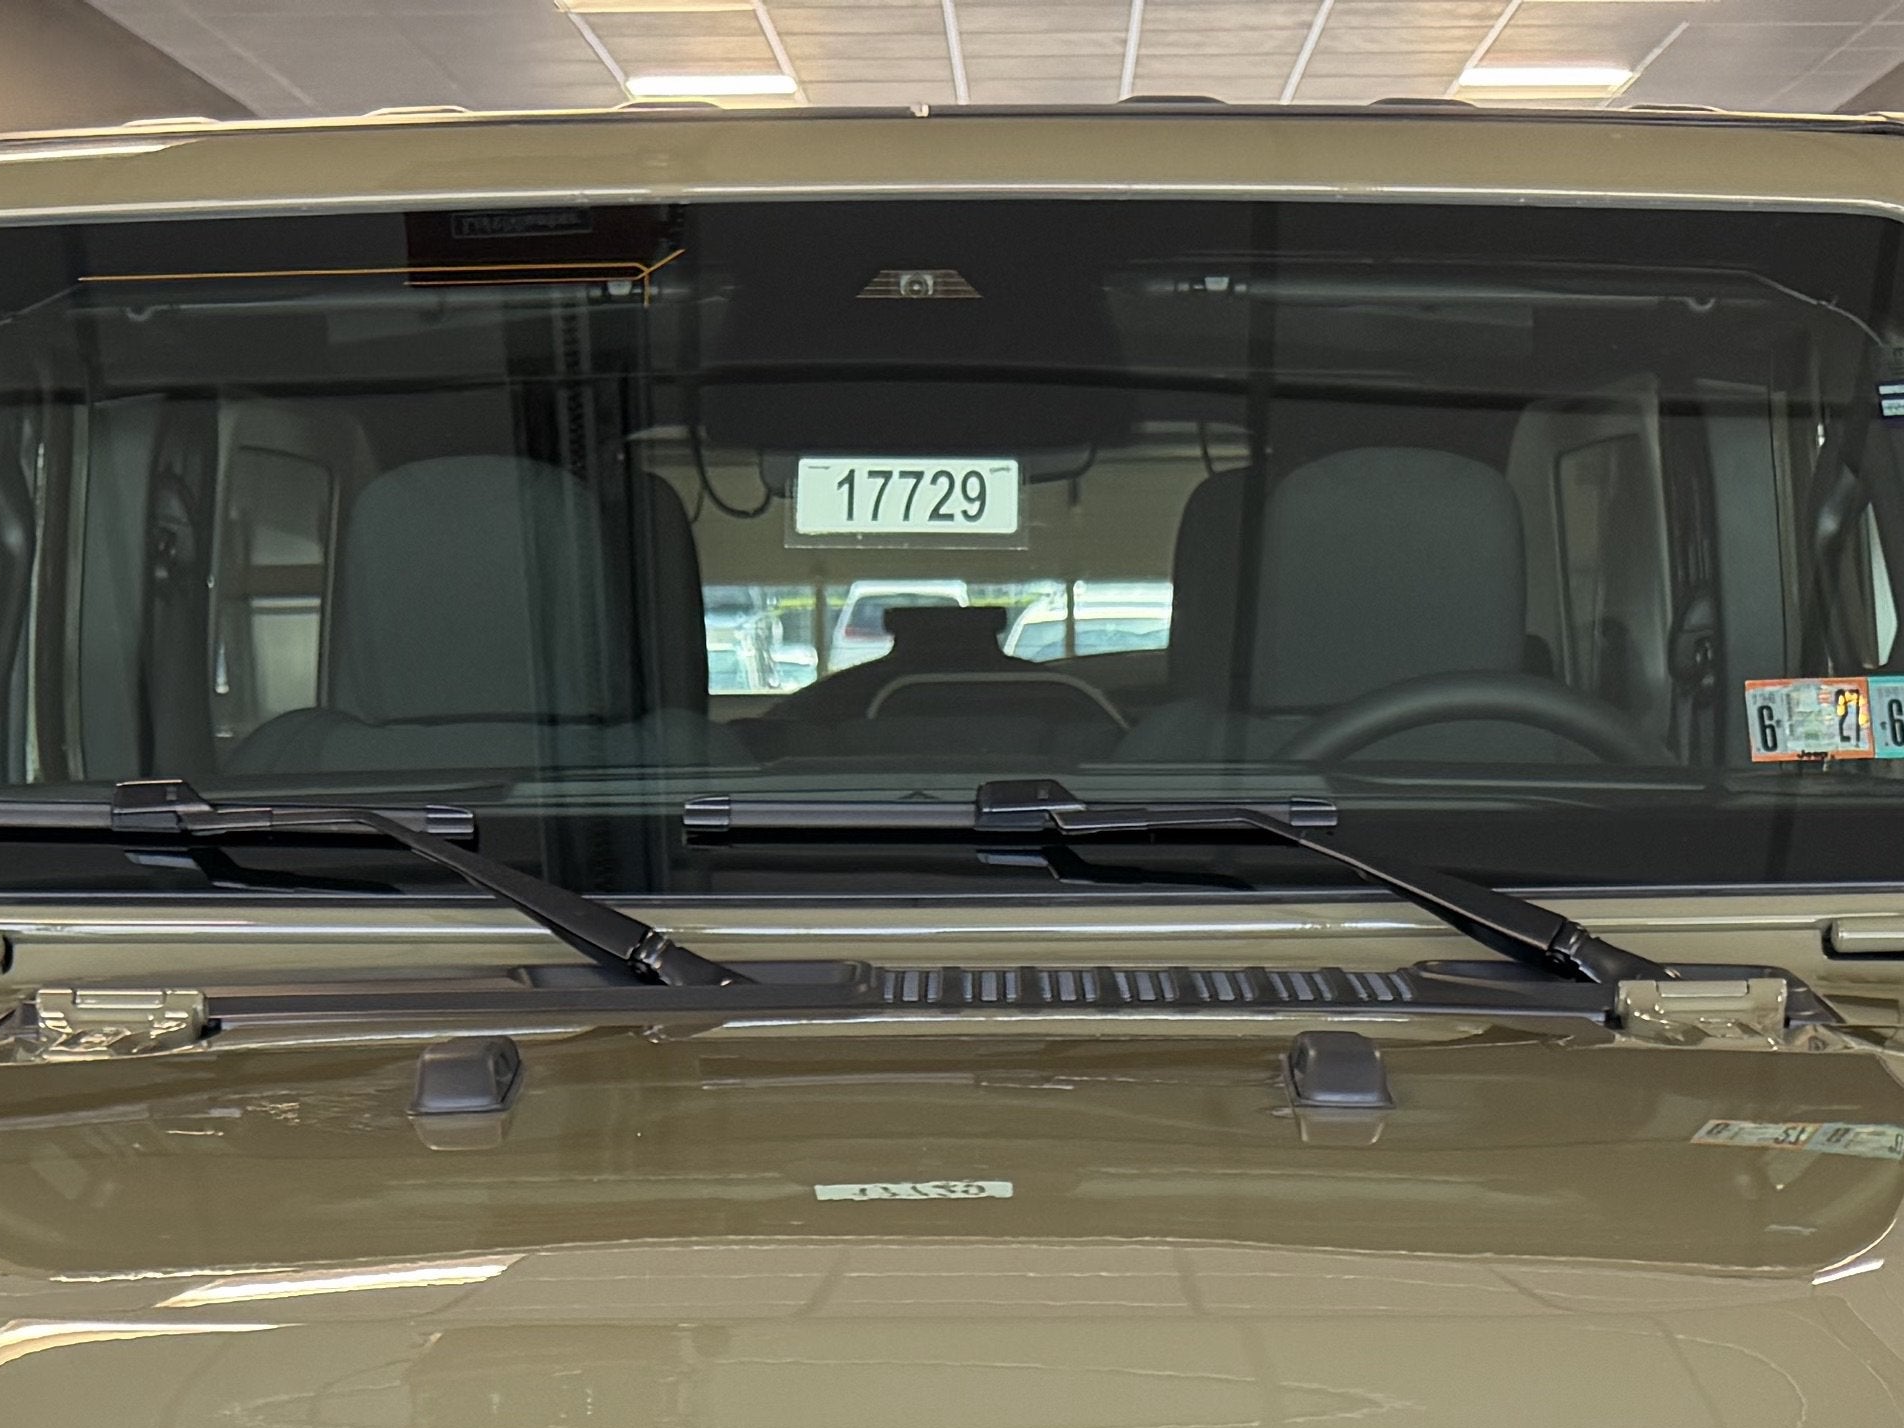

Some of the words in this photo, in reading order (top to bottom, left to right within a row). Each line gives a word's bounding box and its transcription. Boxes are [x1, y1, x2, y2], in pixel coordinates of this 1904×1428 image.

[837, 468, 987, 522] 17729
[1757, 704, 1778, 752] 6
[1835, 688, 1861, 742] 27
